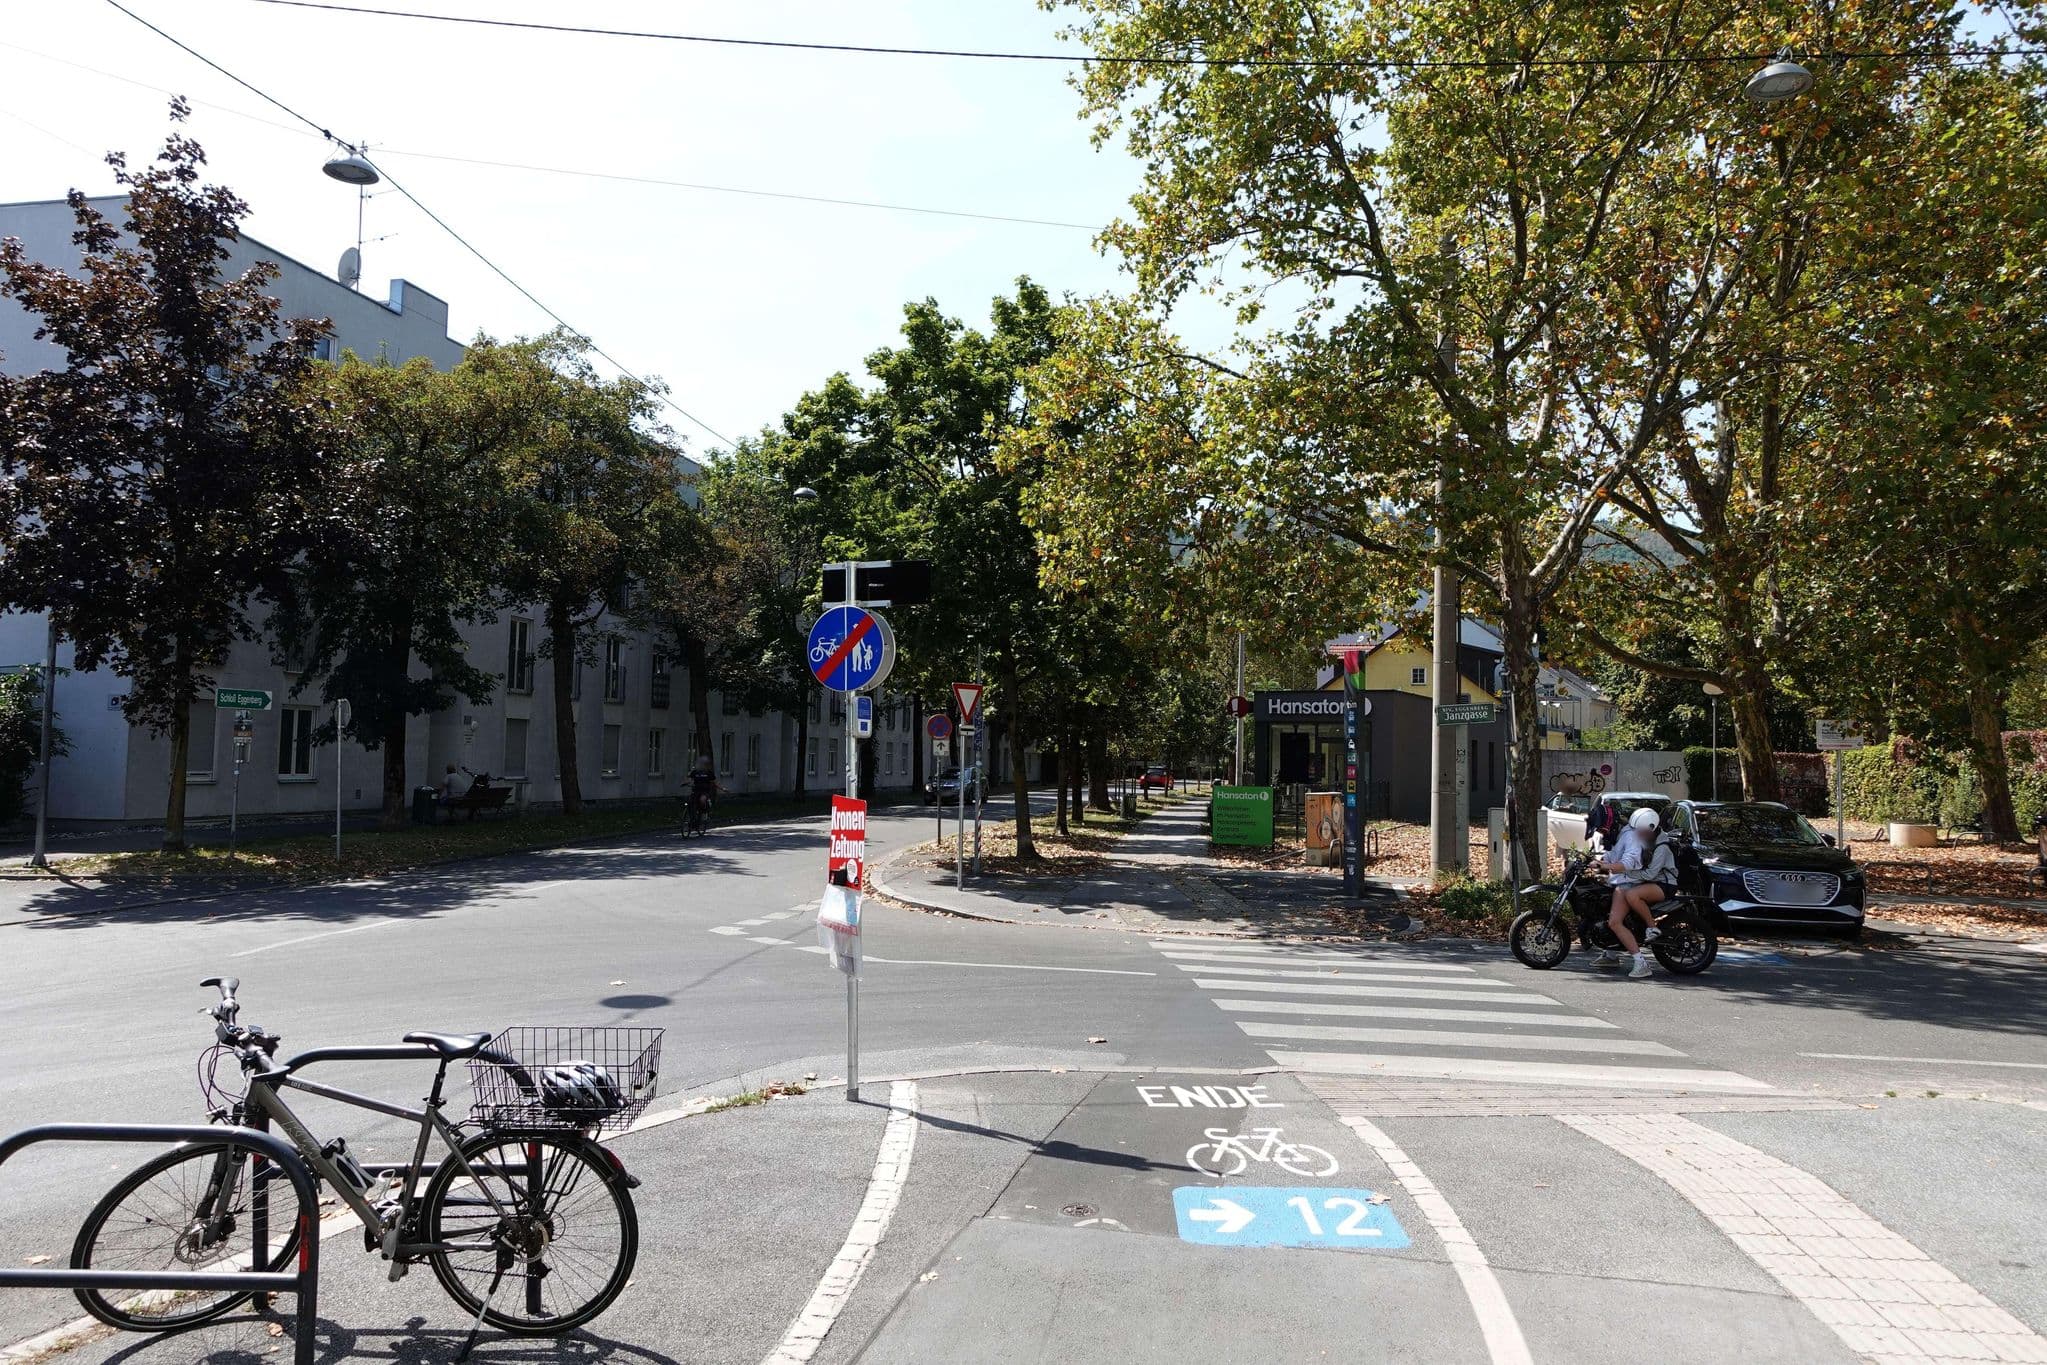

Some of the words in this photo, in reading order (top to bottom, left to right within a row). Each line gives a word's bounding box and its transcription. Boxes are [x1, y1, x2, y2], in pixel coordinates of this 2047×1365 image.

[1444, 711, 1488, 721] Janzgasse
[1217, 791, 1259, 800] Hansaton
[831, 806, 865, 830] Kronen
[830, 834, 865, 862] Zeitung
[1136, 1085, 1285, 1108] ENDE
[1287, 1196, 1383, 1236] 12
